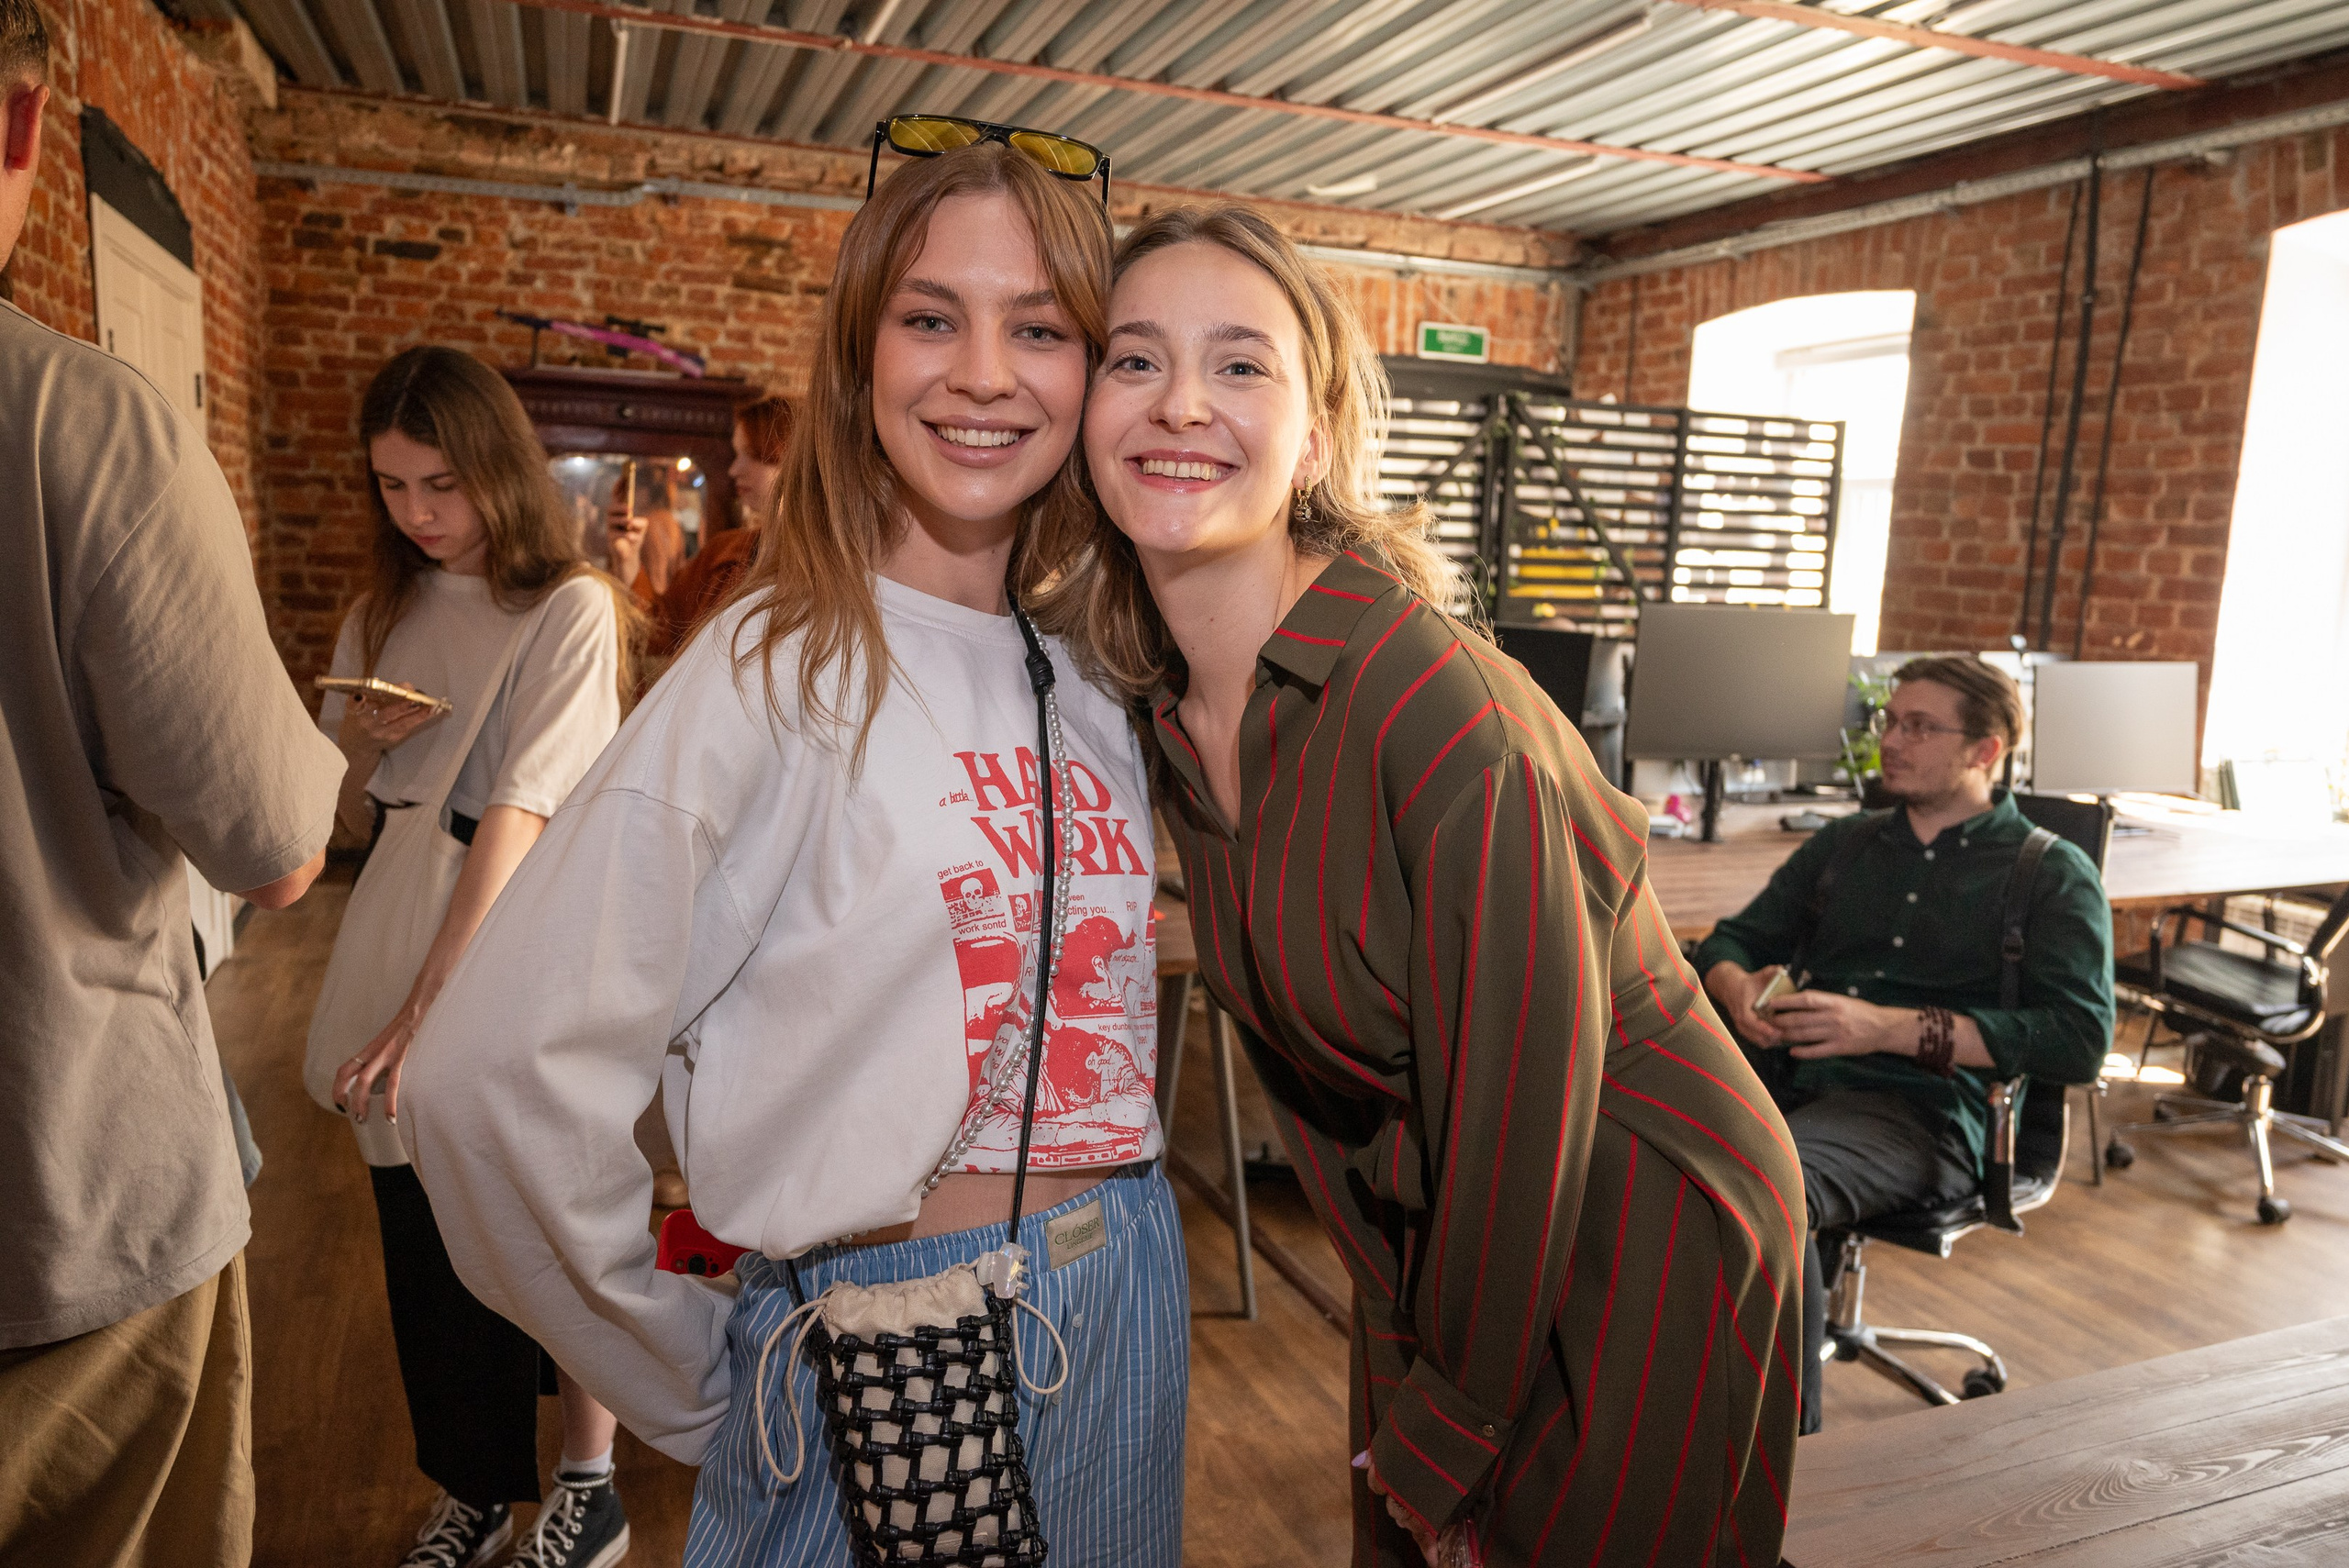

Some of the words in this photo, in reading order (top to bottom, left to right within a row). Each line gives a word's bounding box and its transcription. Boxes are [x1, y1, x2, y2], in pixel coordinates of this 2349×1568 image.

[953, 746, 1112, 812] HAD
[939, 796, 947, 807] a
[970, 809, 1150, 878] WRK
[937, 867, 952, 880] get
[952, 861, 974, 873] back
[974, 859, 985, 868] to
[958, 923, 980, 935] work
[1097, 1023, 1111, 1033] key
[1054, 1217, 1100, 1245] CLÓSER
